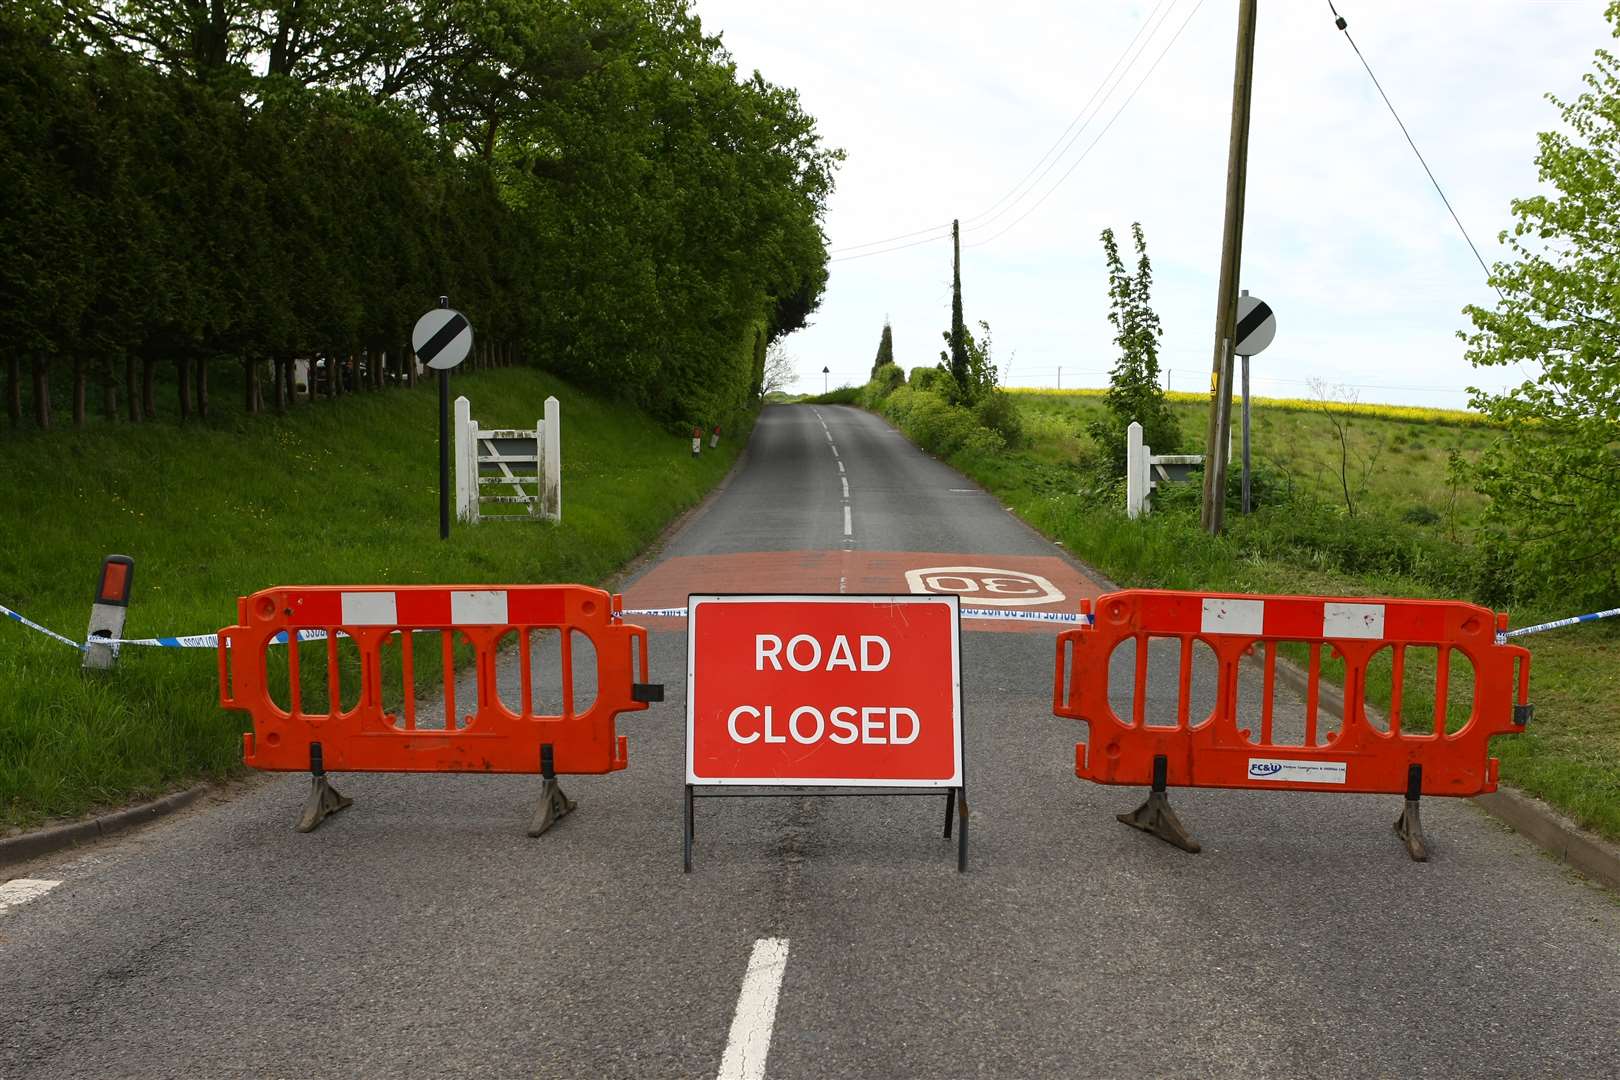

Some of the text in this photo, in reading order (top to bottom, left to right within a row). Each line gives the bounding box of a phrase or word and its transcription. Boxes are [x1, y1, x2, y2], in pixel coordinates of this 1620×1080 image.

[926, 576, 1039, 594] 30
[755, 634, 891, 672] ROAD
[727, 705, 921, 745] CLOSED
